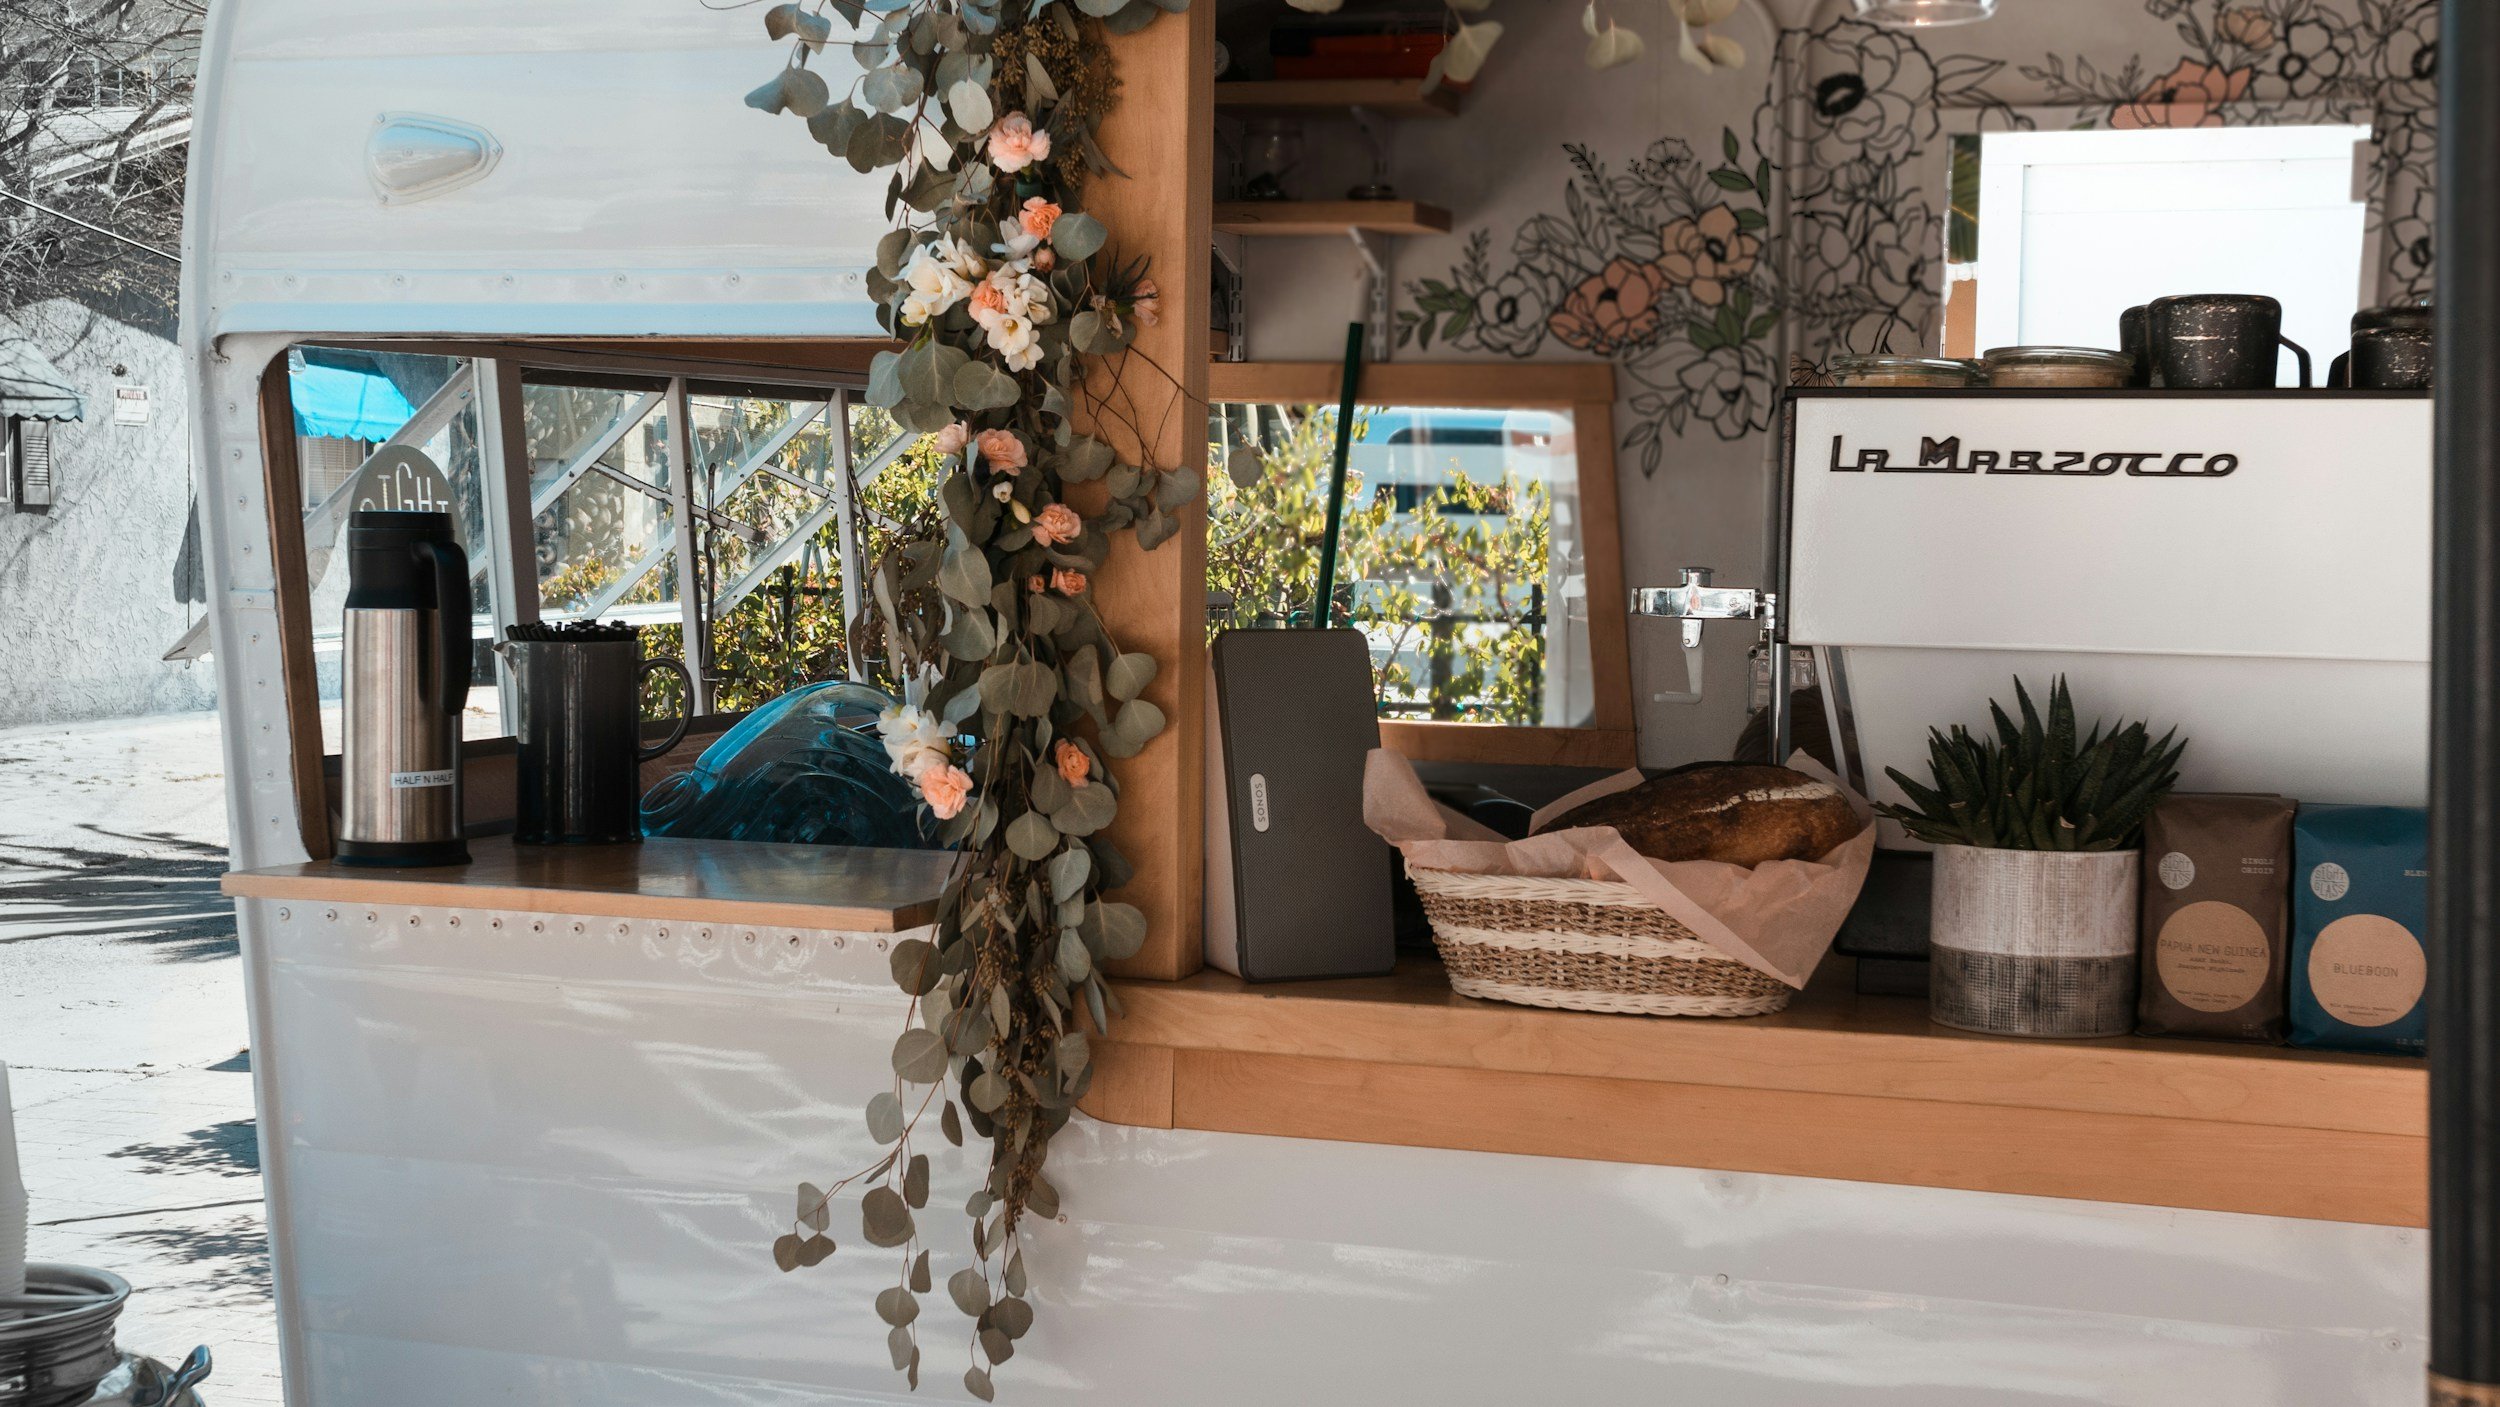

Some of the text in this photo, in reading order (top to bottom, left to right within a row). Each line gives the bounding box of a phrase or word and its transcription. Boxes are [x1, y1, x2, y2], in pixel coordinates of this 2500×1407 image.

[394, 773, 454, 785] HALF N HALF
[1255, 783, 1266, 823] SONOS
[2241, 857, 2275, 865] SINGLE
[2314, 864, 2345, 880] SIGHT
[2314, 881, 2345, 899] GLASS
[2160, 939, 2266, 958] PAPUA NEW GUINEA
[2333, 962, 2399, 977] BLUEBOON
